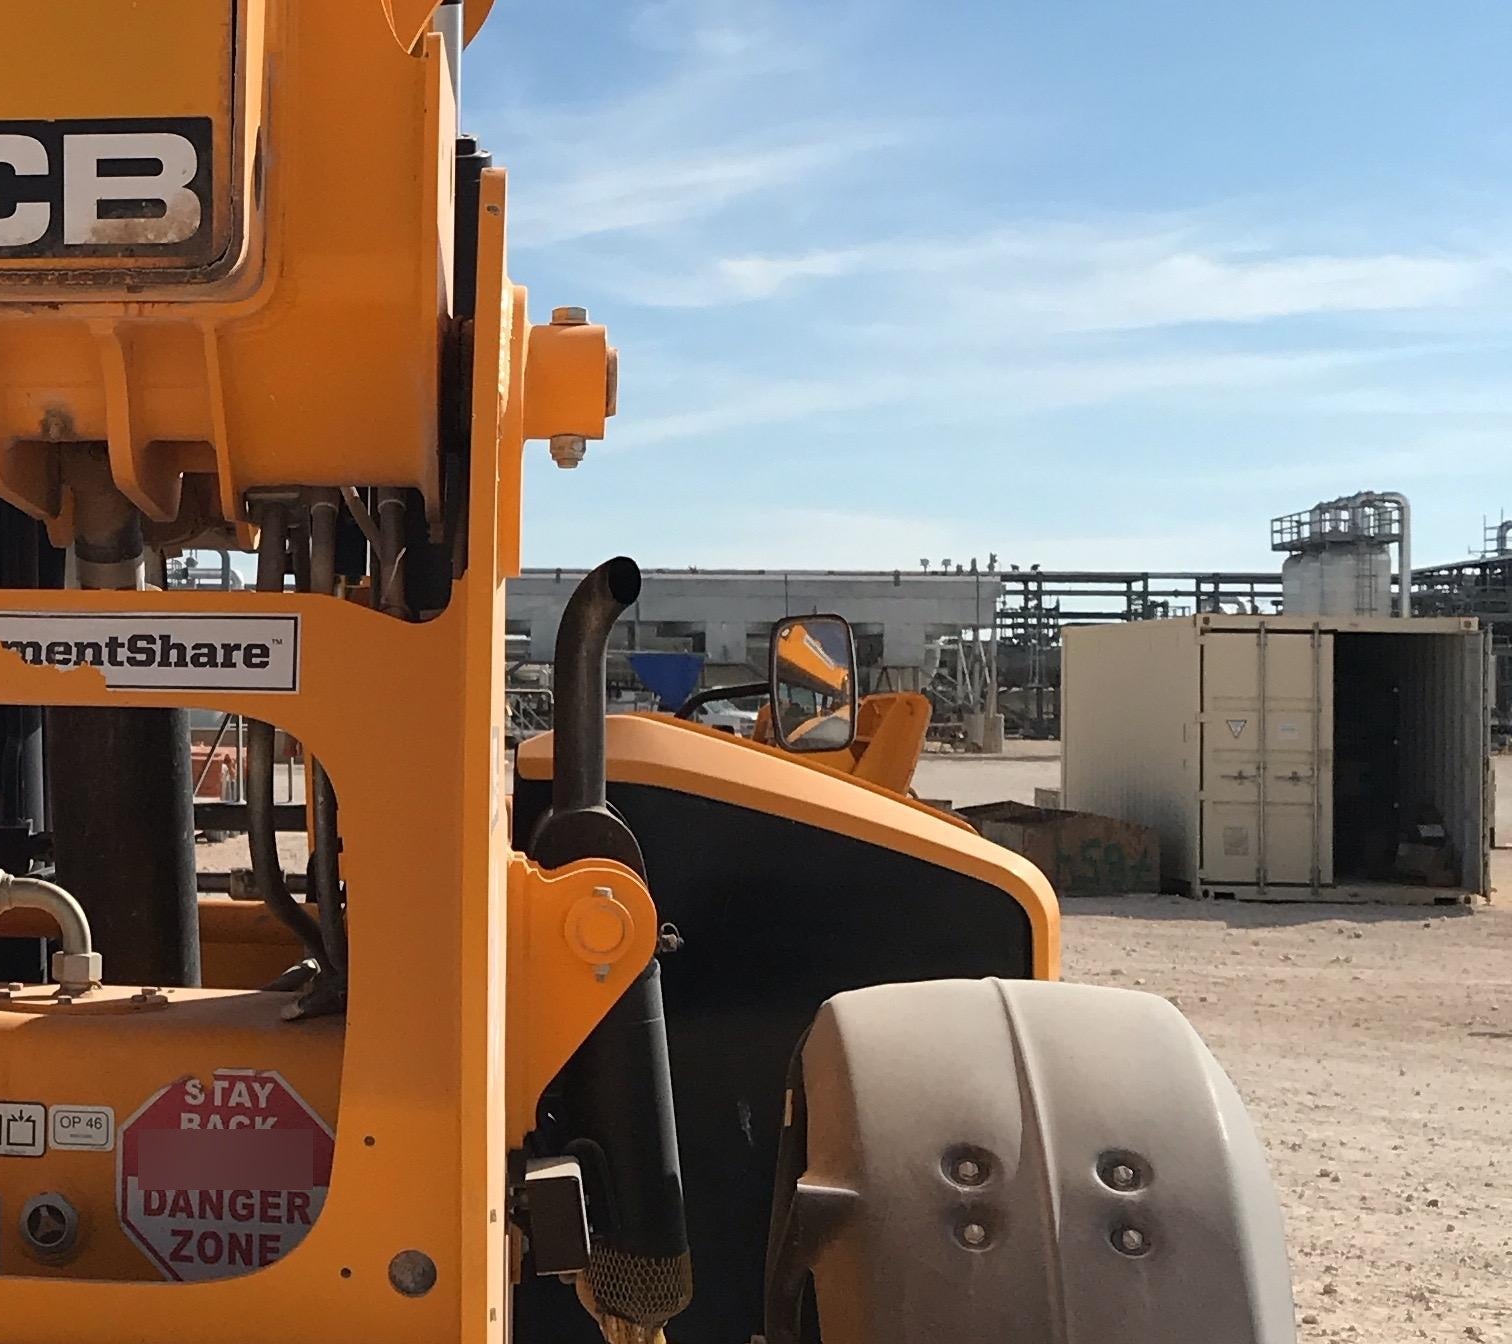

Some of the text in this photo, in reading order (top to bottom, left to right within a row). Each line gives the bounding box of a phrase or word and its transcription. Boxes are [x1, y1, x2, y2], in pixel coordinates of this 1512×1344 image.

[183, 1078, 275, 1109] STAY
[59, 1115, 103, 1130] OP 46
[143, 1189, 312, 1226] DANGER
[168, 1228, 282, 1268] ZONE
